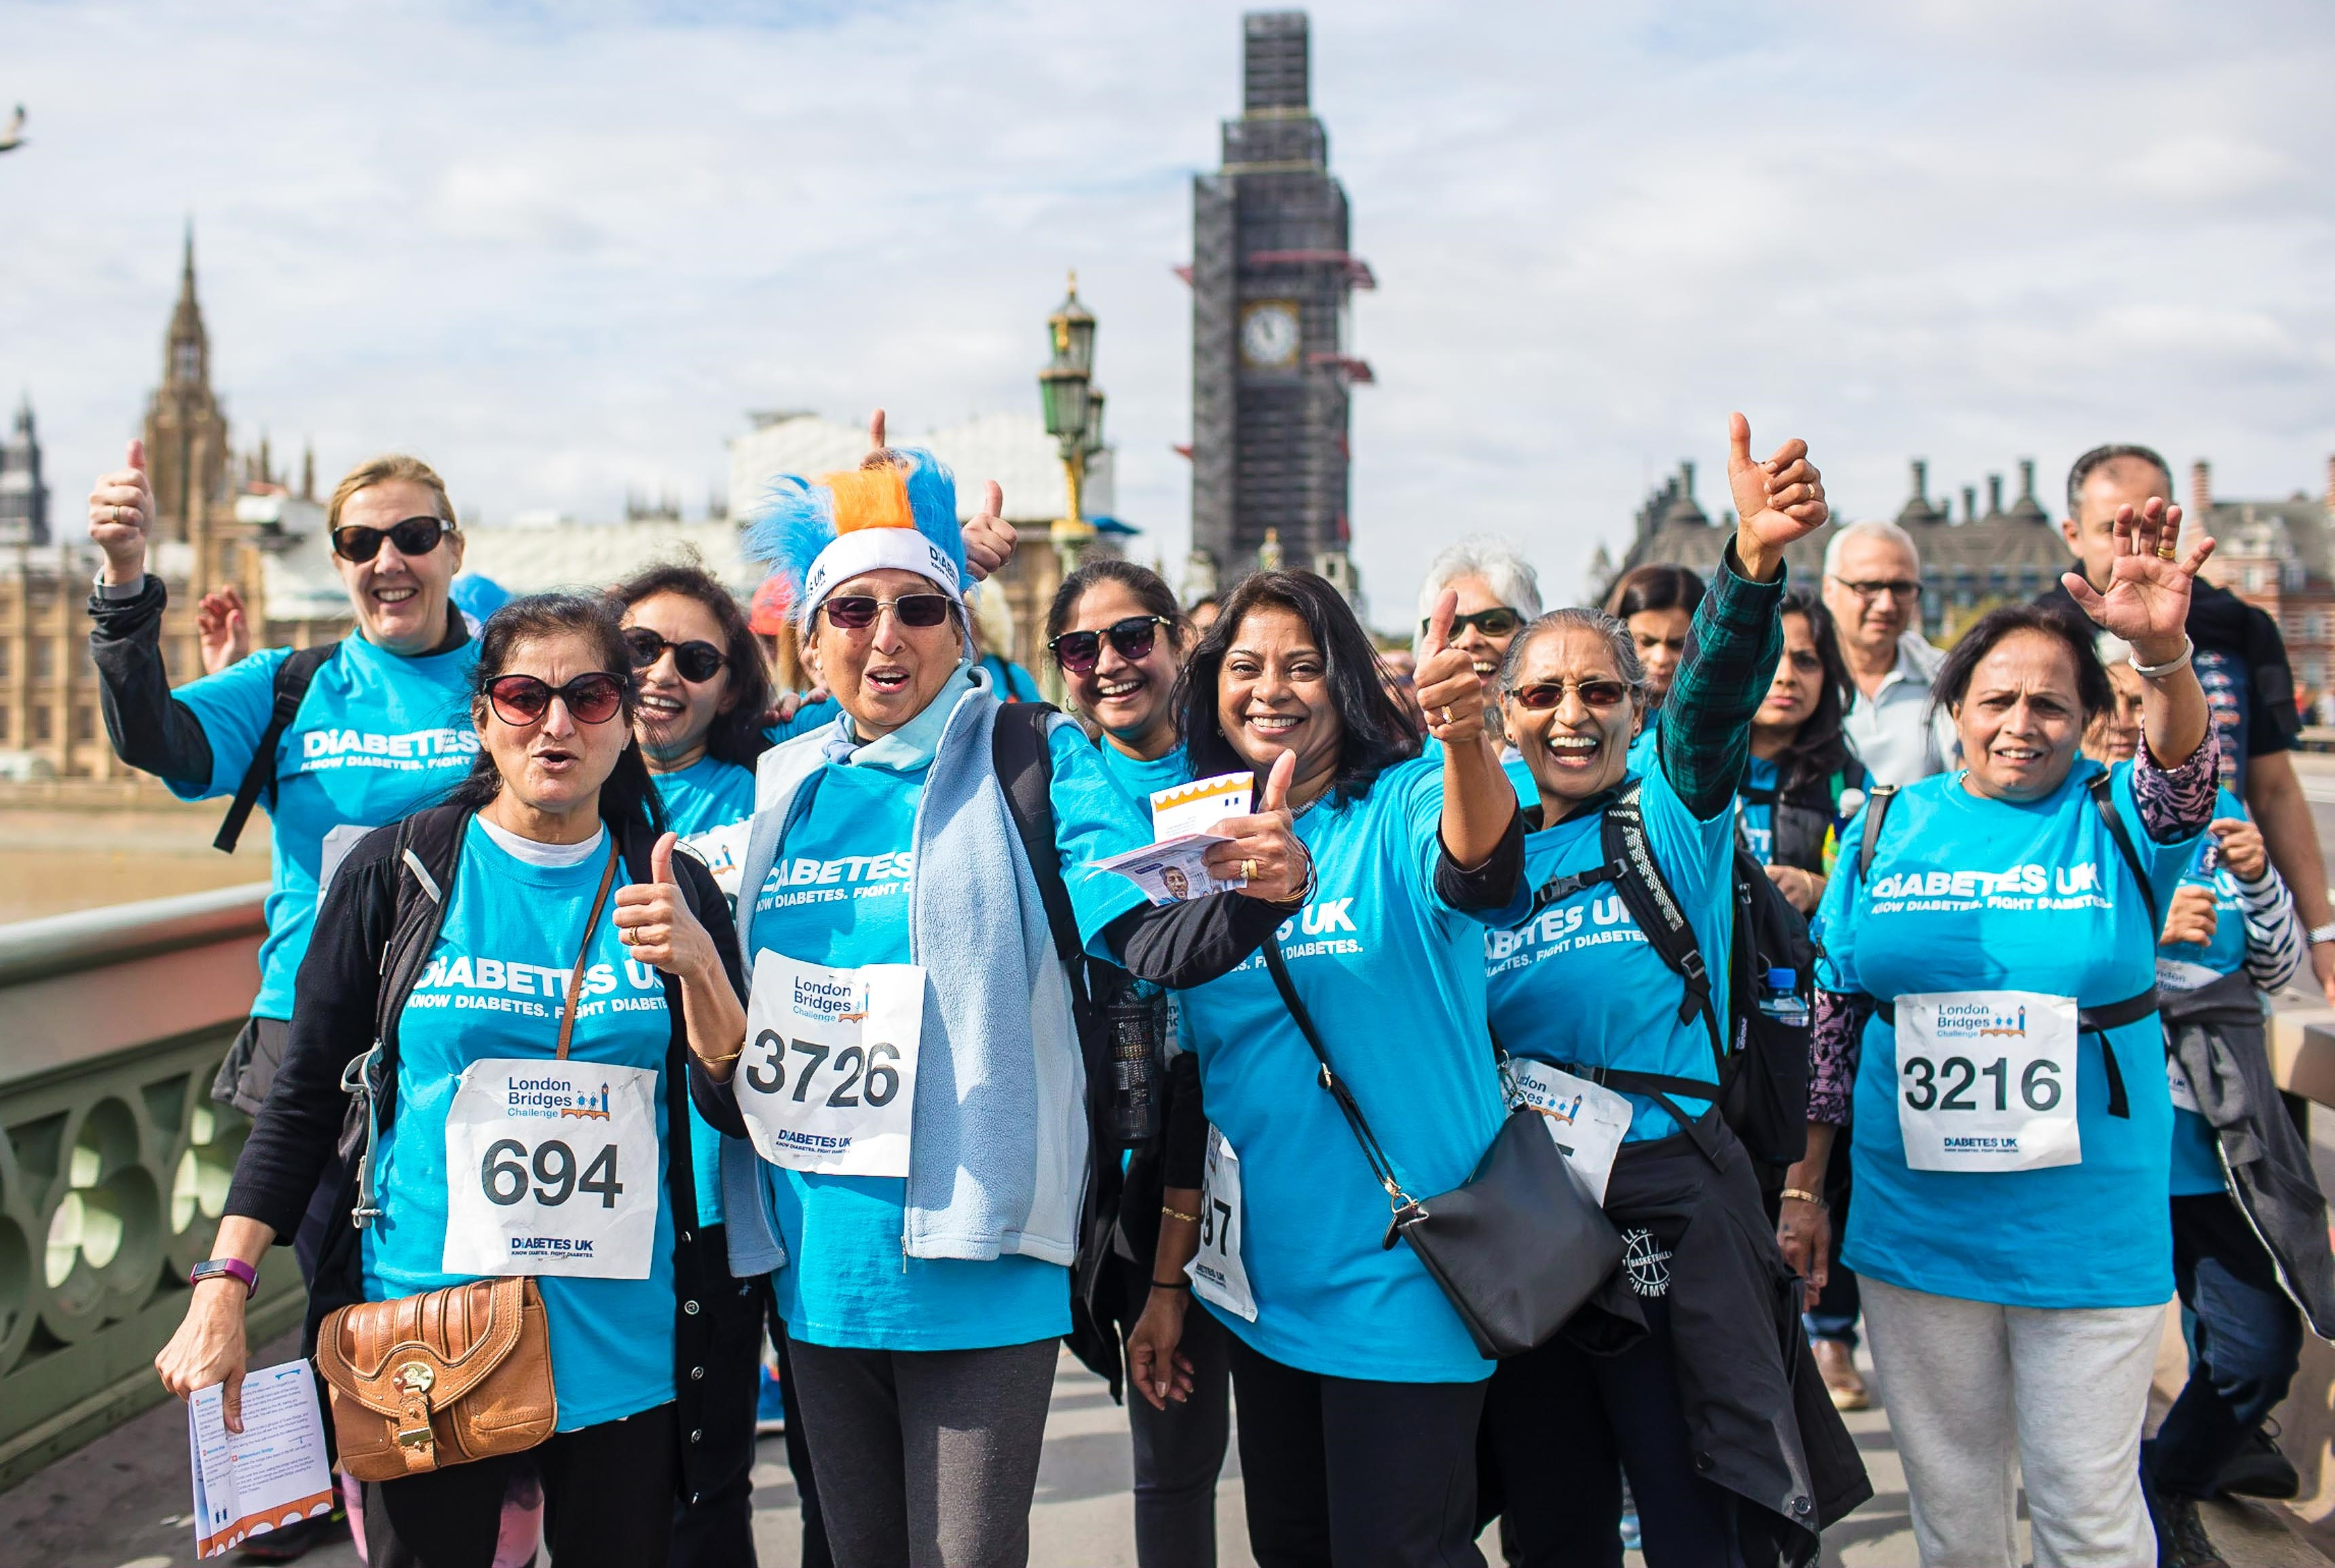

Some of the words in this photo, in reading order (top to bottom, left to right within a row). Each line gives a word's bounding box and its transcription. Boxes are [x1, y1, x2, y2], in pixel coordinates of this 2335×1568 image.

[300, 756, 343, 771] KNOW
[345, 755, 424, 770] DIABETES.
[2055, 862, 2103, 895] UK
[774, 888, 848, 908] DIABETES.
[853, 882, 900, 899] FIGHT
[1987, 895, 2034, 911] FIGHT
[1301, 897, 1358, 935] UK
[1286, 939, 1364, 960] DIABETES.
[1535, 939, 1571, 963] FIGHT
[624, 958, 665, 990] U
[794, 975, 851, 997] London
[408, 993, 451, 1009] KNOW
[454, 994, 549, 1018] DIABETES.
[554, 997, 606, 1020] FGHT
[612, 991, 668, 1012] DIABETE
[793, 990, 851, 1013] Bridges
[1938, 1004, 1989, 1015] London
[792, 1005, 836, 1022] Challenge
[1937, 1017, 1990, 1030] Bridges
[1937, 1030, 1979, 1039] Challenge
[746, 1028, 901, 1108] 3726
[508, 1077, 572, 1091] London
[1903, 1056, 2062, 1112] 3216
[508, 1091, 572, 1108] Bridges
[507, 1107, 559, 1119] Challenge
[778, 1128, 837, 1148] DiABETES
[838, 1137, 853, 1148] UK
[1944, 1137, 1998, 1148] DiABETES
[2001, 1138, 2019, 1148] UK
[481, 1138, 624, 1209] 694
[574, 1239, 594, 1252] UK
